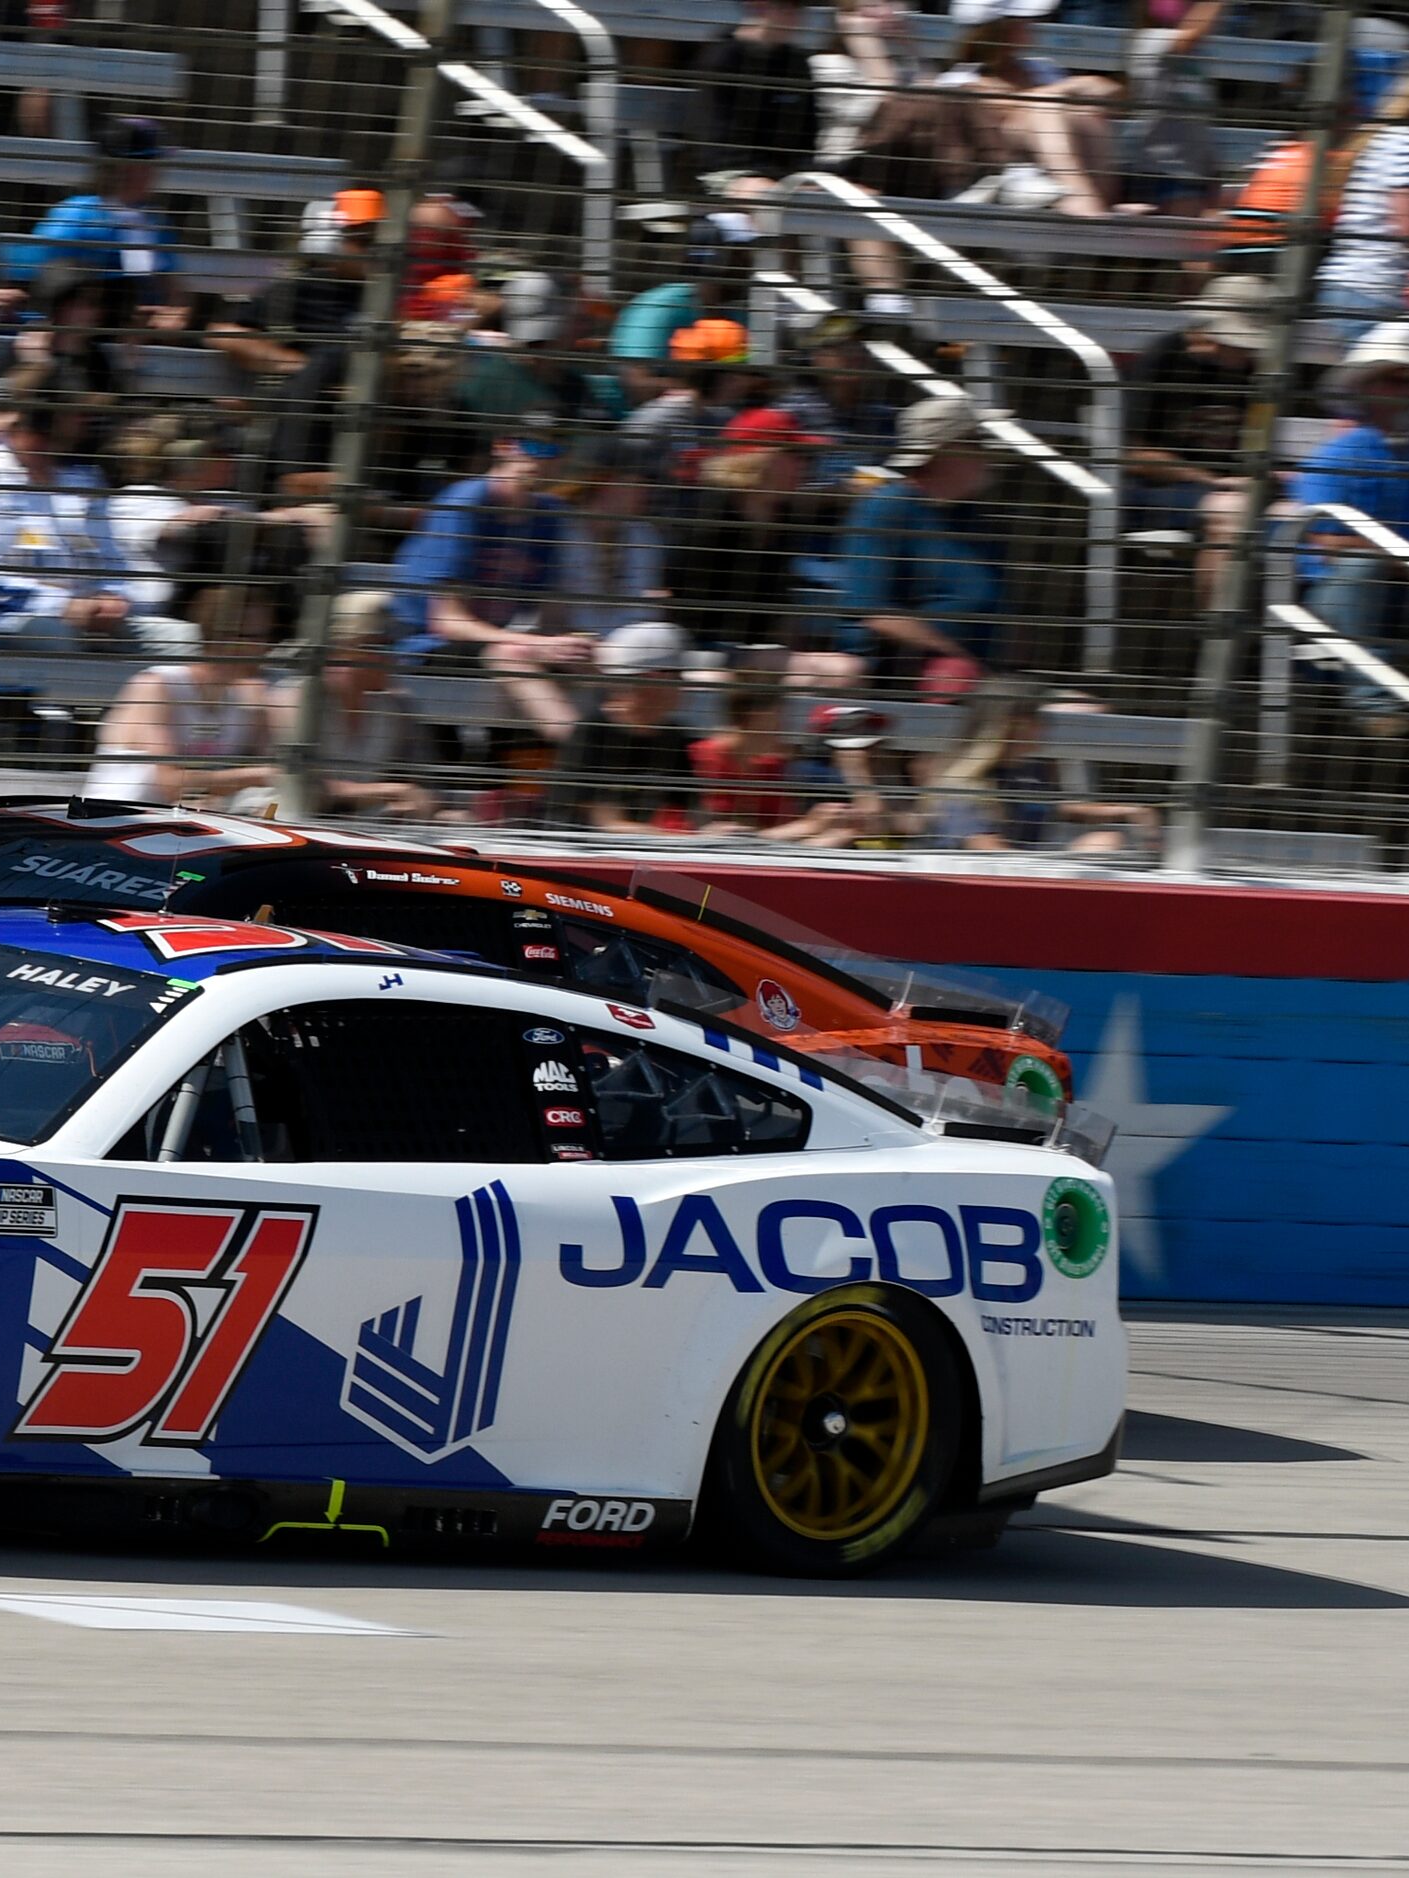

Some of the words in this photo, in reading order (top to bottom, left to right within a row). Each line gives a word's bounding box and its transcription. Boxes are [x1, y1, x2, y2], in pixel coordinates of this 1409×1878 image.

[10, 855, 172, 901] SUÁREZ
[544, 892, 615, 918] SIEMENS
[6, 963, 137, 997] HALEY
[22, 1043, 66, 1060] NASCAR
[533, 1060, 577, 1083] MAC
[534, 1083, 579, 1093] TOOLS
[545, 1110, 584, 1124] CRC
[0, 1187, 44, 1204] NASCAR
[9, 1210, 46, 1225] SERIES
[559, 1194, 1044, 1304] JACOB
[8, 1196, 319, 1446] 51
[541, 1498, 656, 1532] FORD
